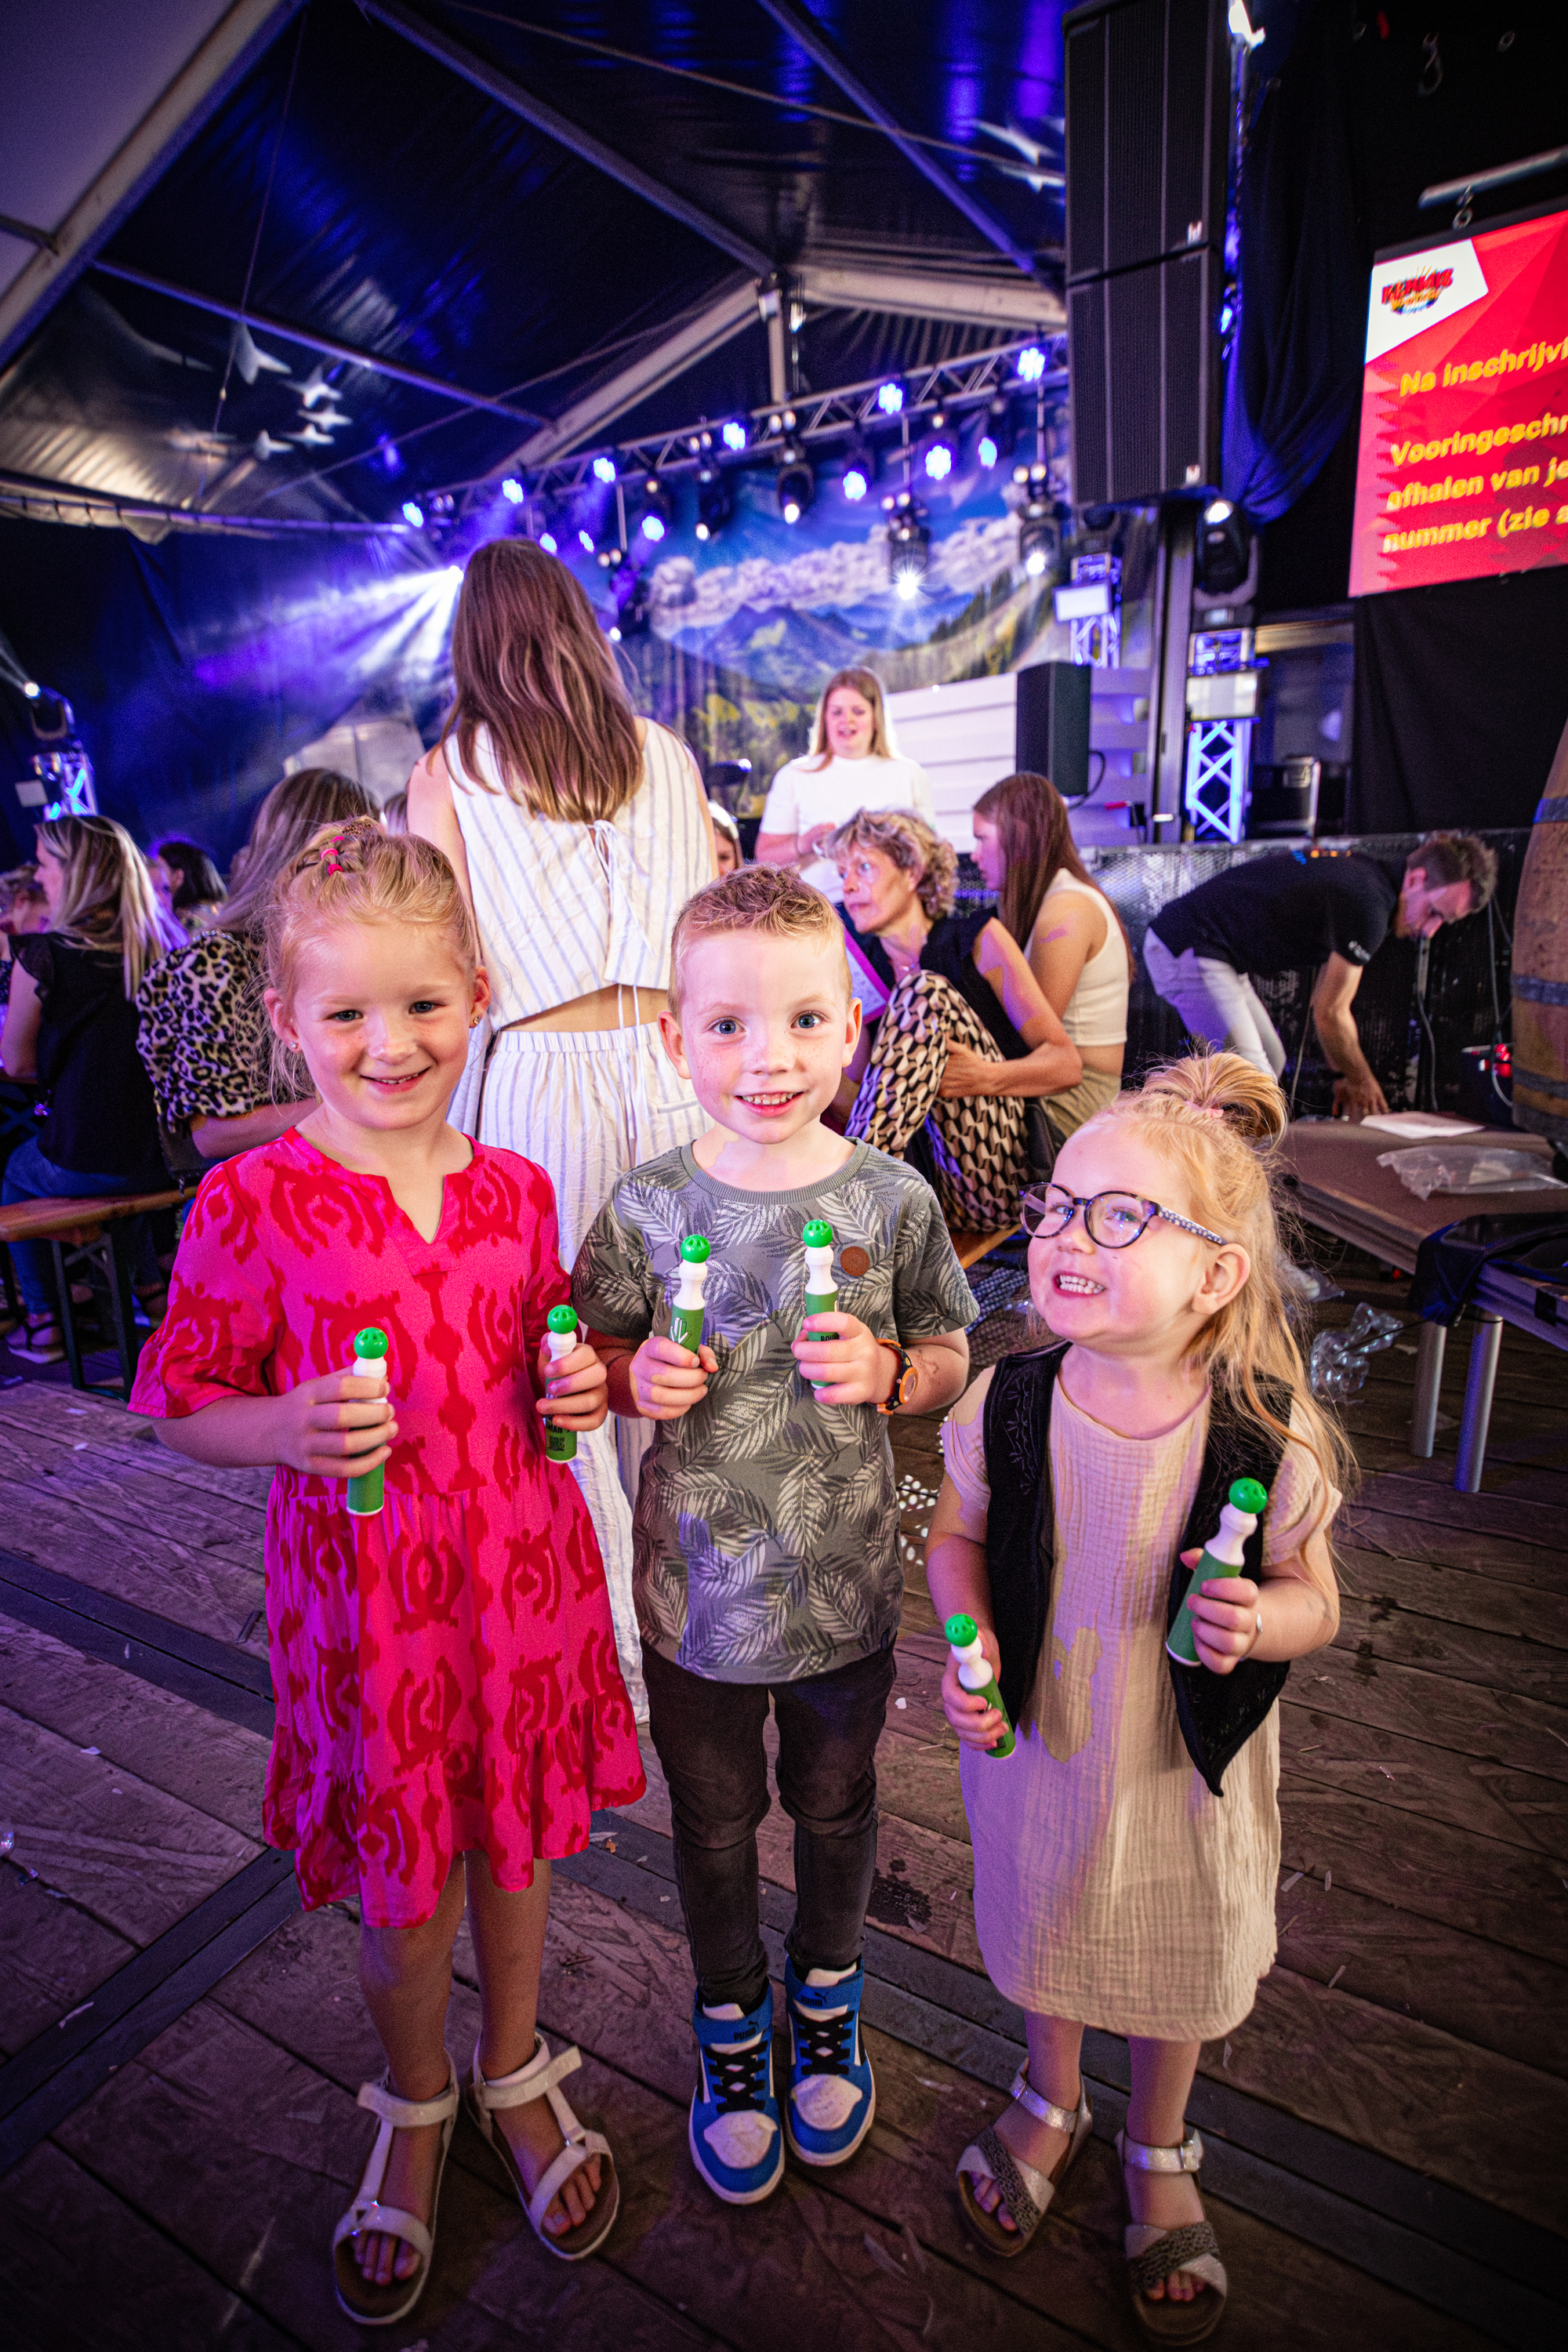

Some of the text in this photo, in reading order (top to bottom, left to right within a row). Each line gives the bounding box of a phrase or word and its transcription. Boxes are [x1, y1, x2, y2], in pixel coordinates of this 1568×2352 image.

[1400, 371, 1436, 397] Na
[1387, 456, 1568, 510] afhalen van je
[1383, 517, 1492, 554] nummer
[1497, 506, 1550, 538] (zie
